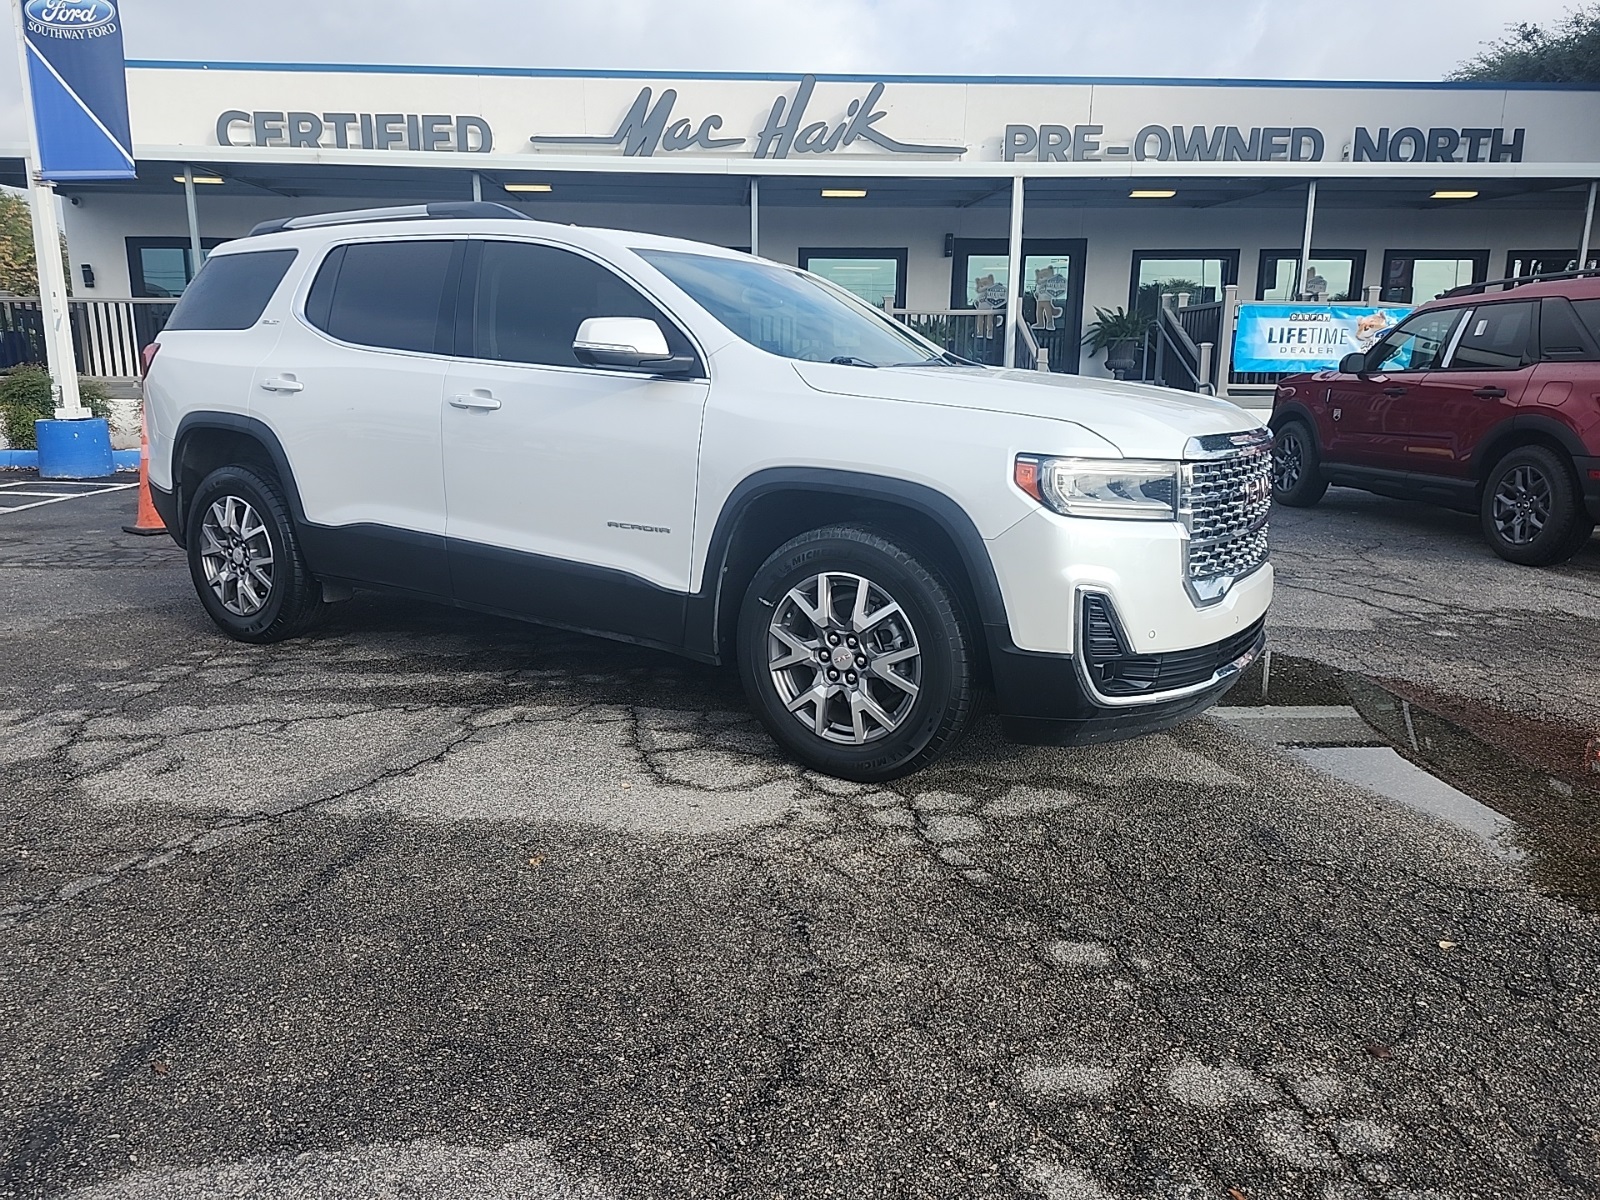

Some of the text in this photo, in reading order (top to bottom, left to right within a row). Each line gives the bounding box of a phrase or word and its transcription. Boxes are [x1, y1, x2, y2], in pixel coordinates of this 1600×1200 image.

[42, 0, 97, 22] Ford
[27, 21, 117, 40] SOUTHWAY FORD
[531, 74, 968, 159] Mac Haik
[216, 109, 493, 153] CERTIFIED
[1004, 124, 1526, 162] PRE-OWNED NORTH
[1268, 327, 1349, 345] LIFETIME
[607, 521, 671, 534] ACADIA
